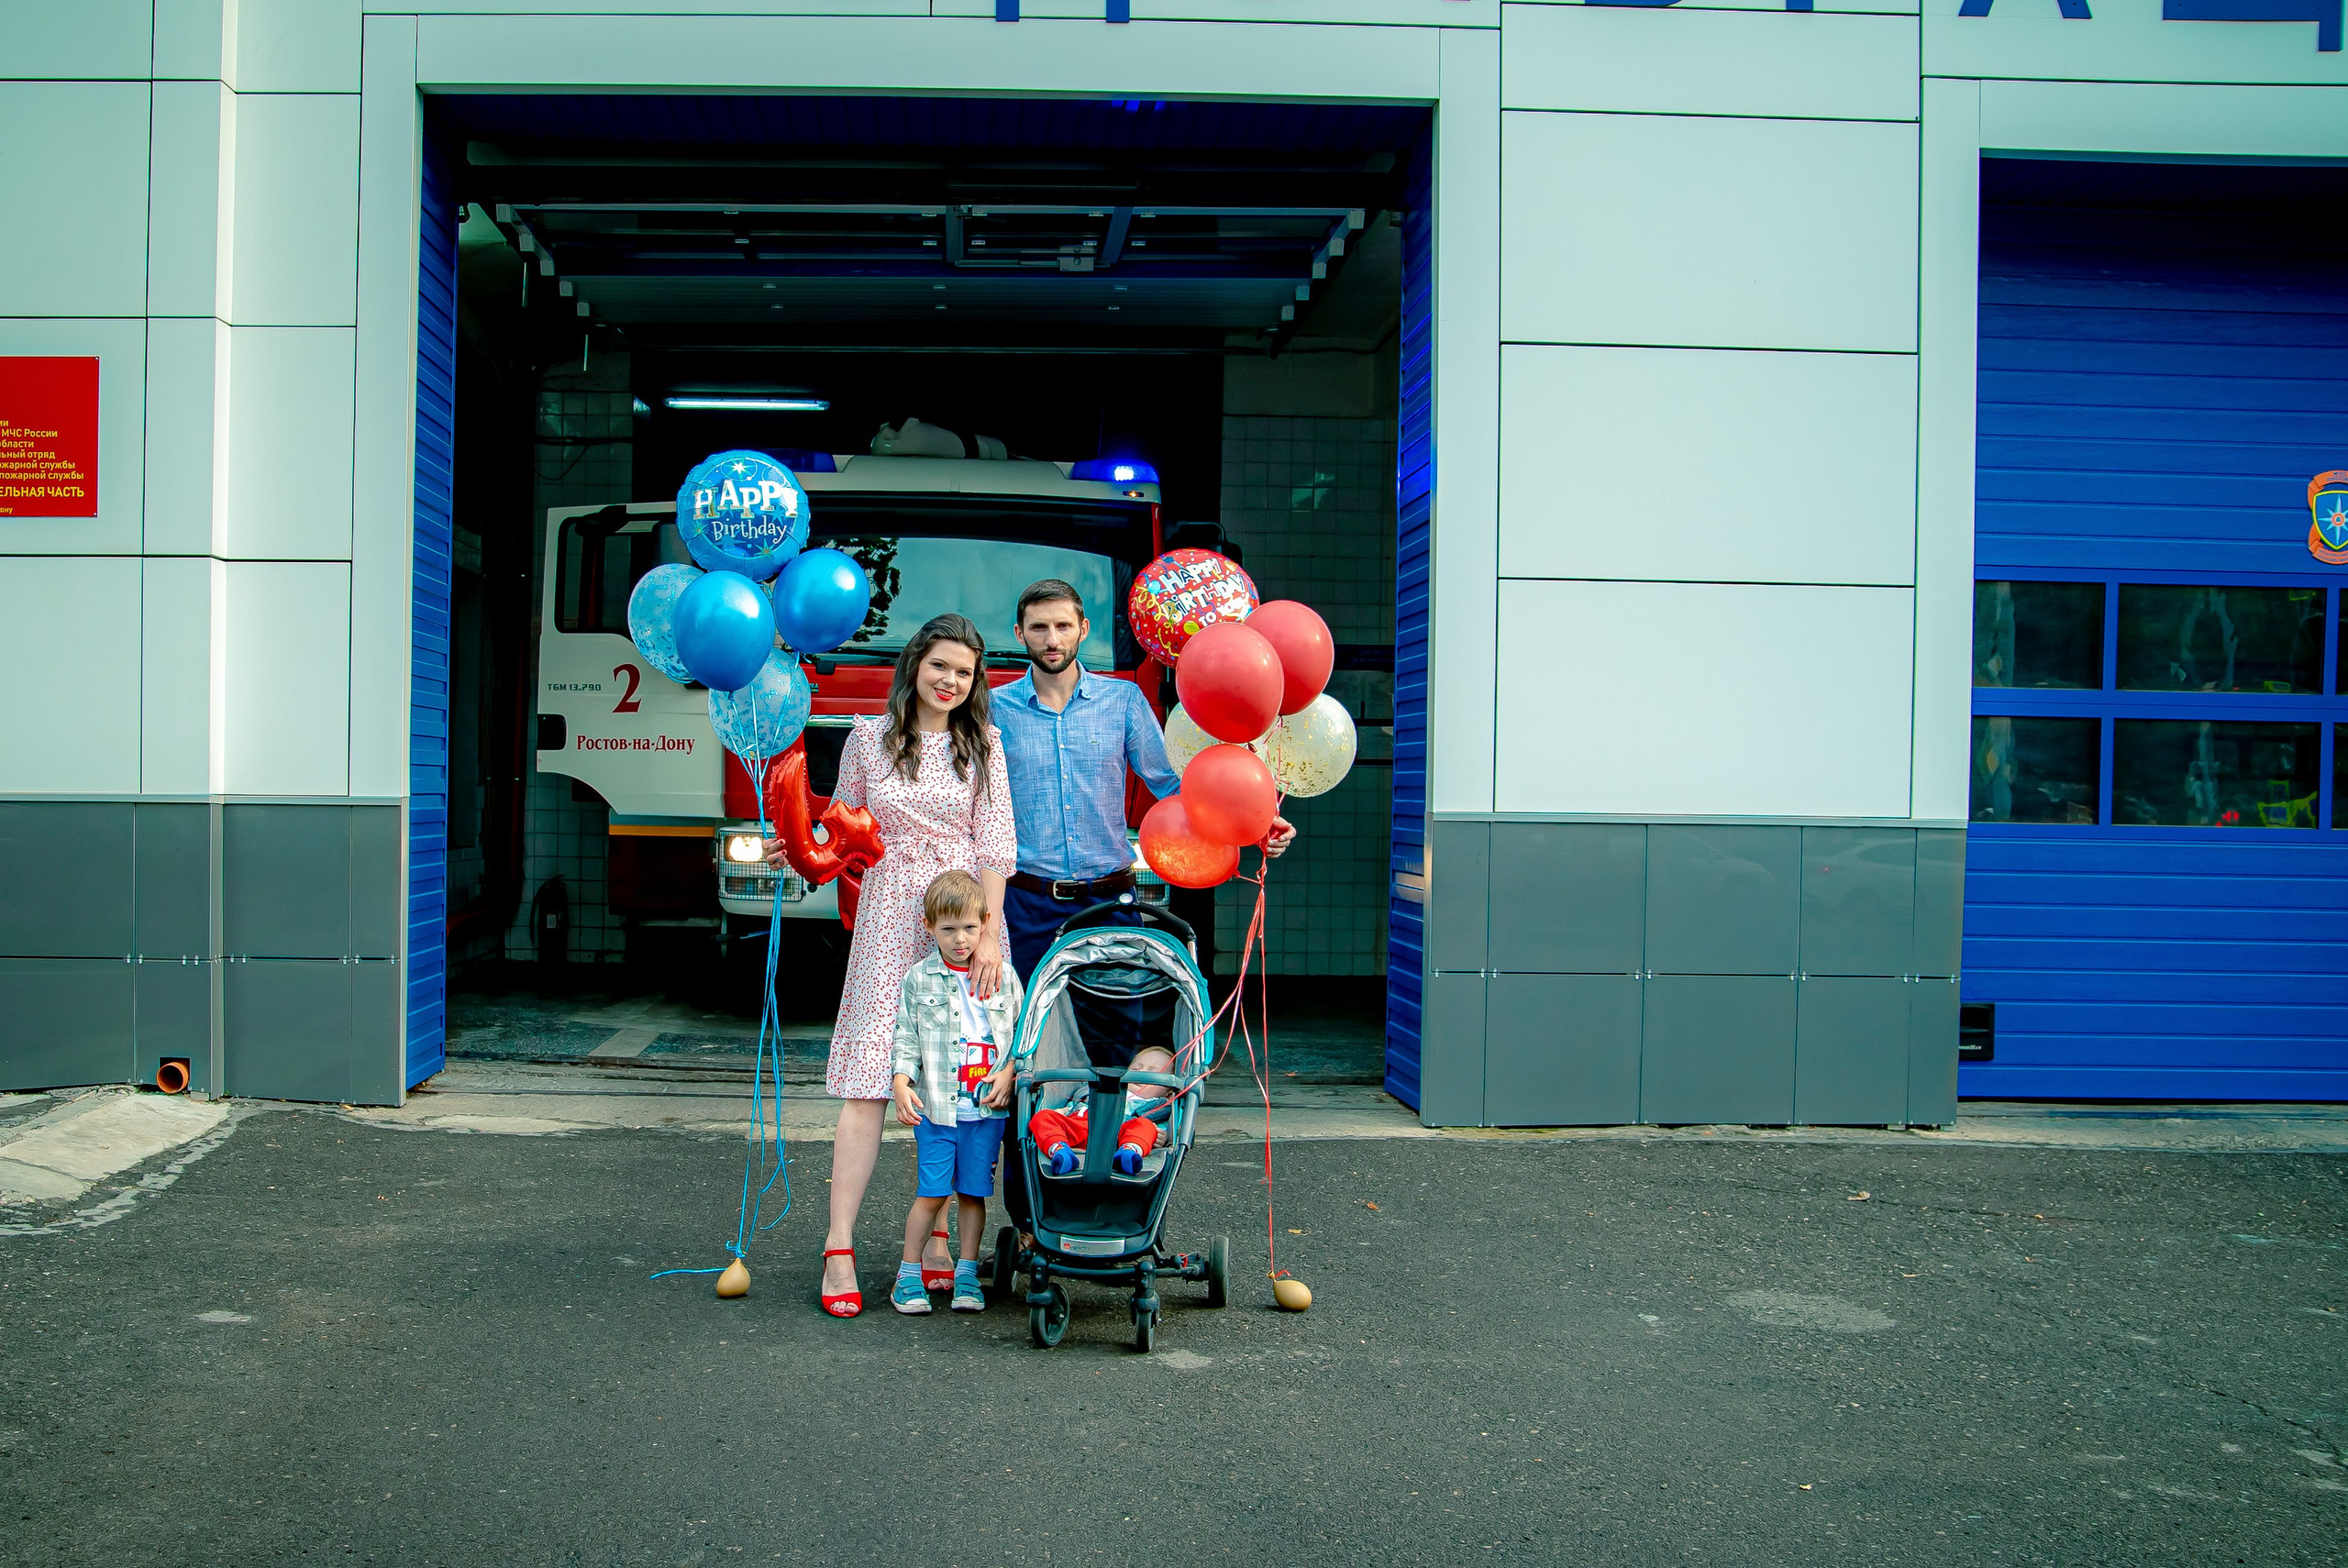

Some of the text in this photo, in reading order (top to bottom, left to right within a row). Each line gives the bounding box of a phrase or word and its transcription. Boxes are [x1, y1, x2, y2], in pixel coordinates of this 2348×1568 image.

[1, 428, 58, 438] МЧС России
[0, 439, 35, 448] бласти
[0, 448, 56, 460] ьный отряд
[0, 459, 76, 471] жарной службы
[0, 469, 84, 481] пожарной службы
[47, 486, 85, 497] ЧАСТЬ
[711, 514, 788, 545] Birthday
[1158, 558, 1222, 593] HAPPY
[1198, 612, 1218, 627] TO
[547, 683, 567, 691] TGM
[612, 663, 642, 713] 2
[577, 735, 695, 755] Ростов-на-Дону
